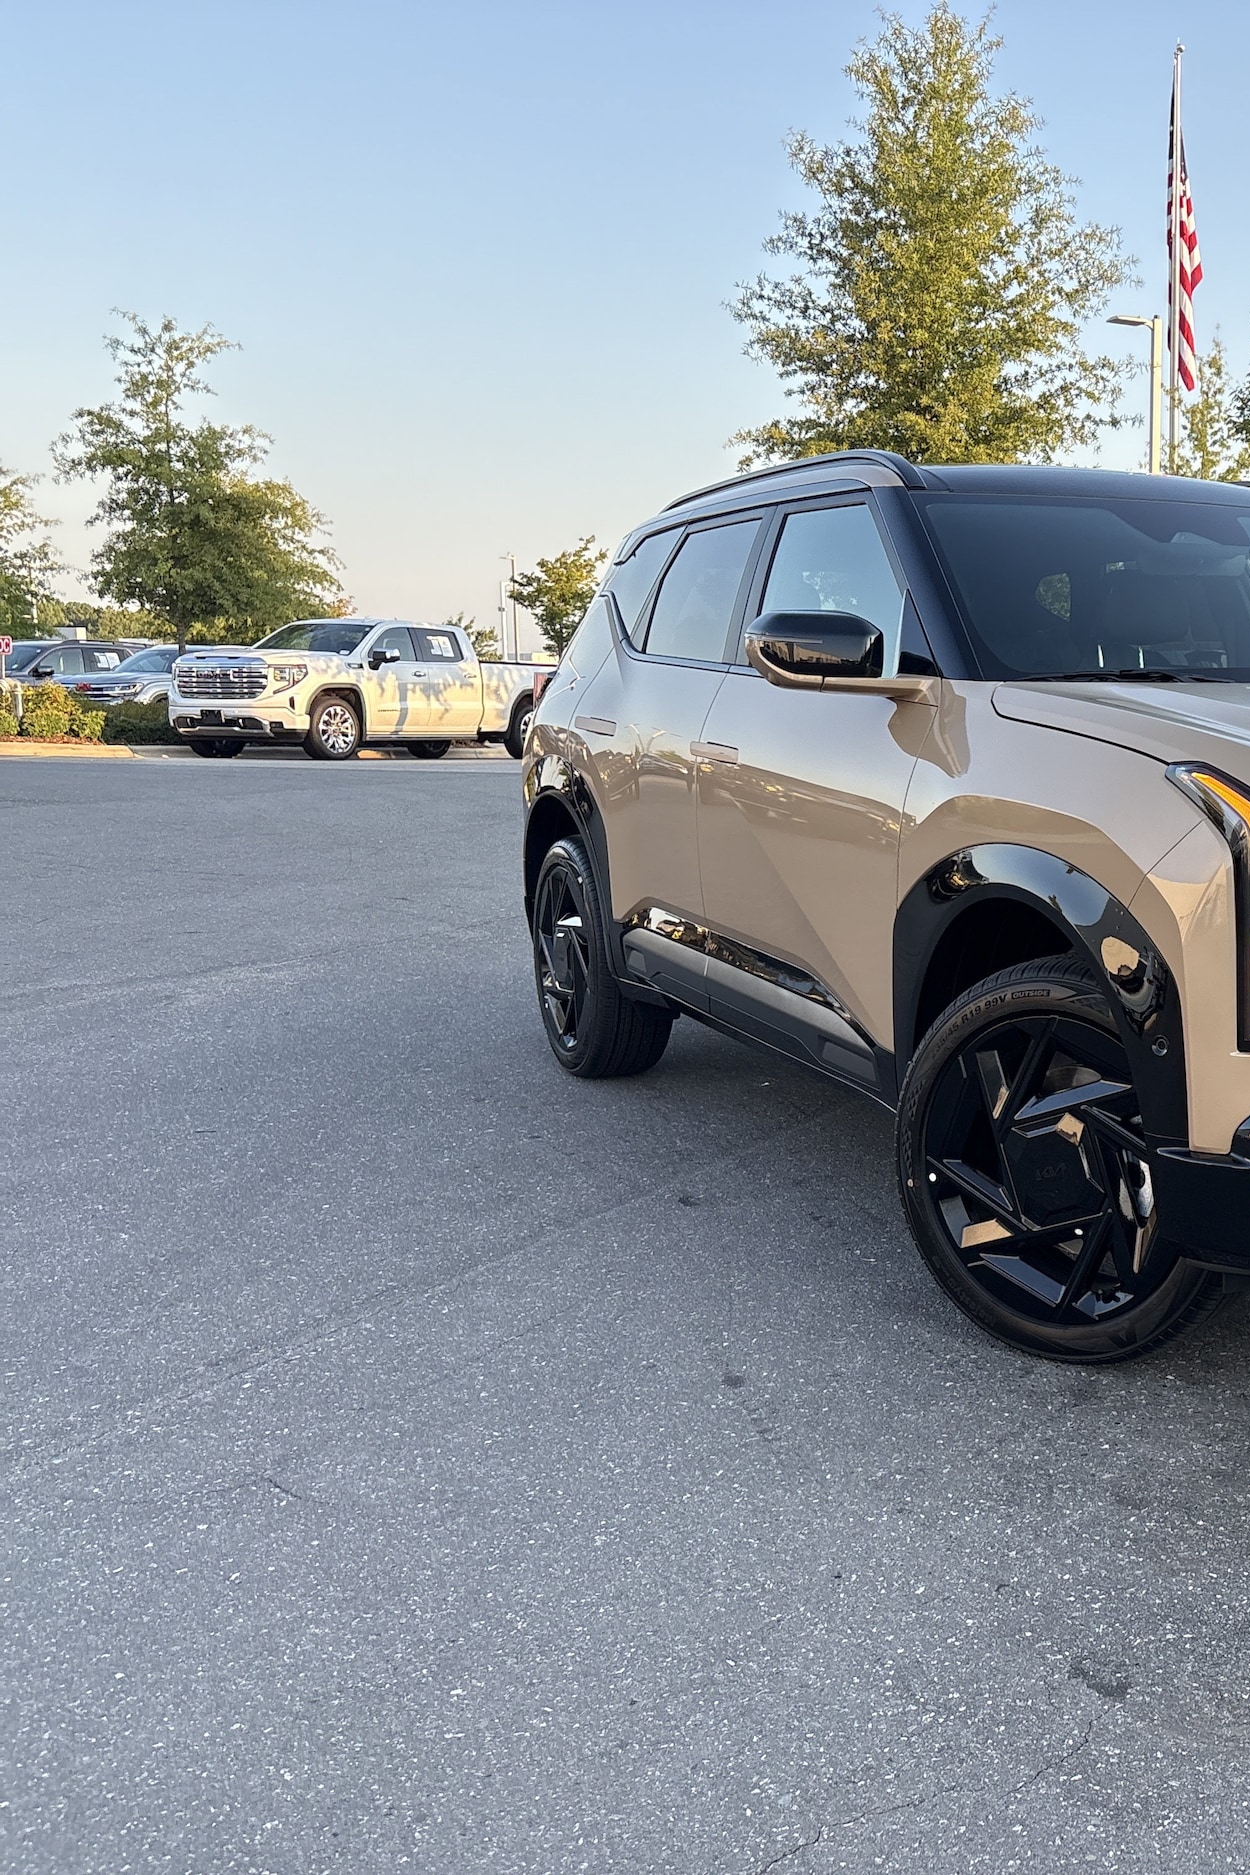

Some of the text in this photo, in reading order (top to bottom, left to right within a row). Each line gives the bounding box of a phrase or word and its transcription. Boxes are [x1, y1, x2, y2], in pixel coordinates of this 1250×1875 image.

[960, 1005, 982, 1024] R19
[984, 993, 1008, 1010] 99V
[1012, 989, 1051, 999] OUTSIDE
